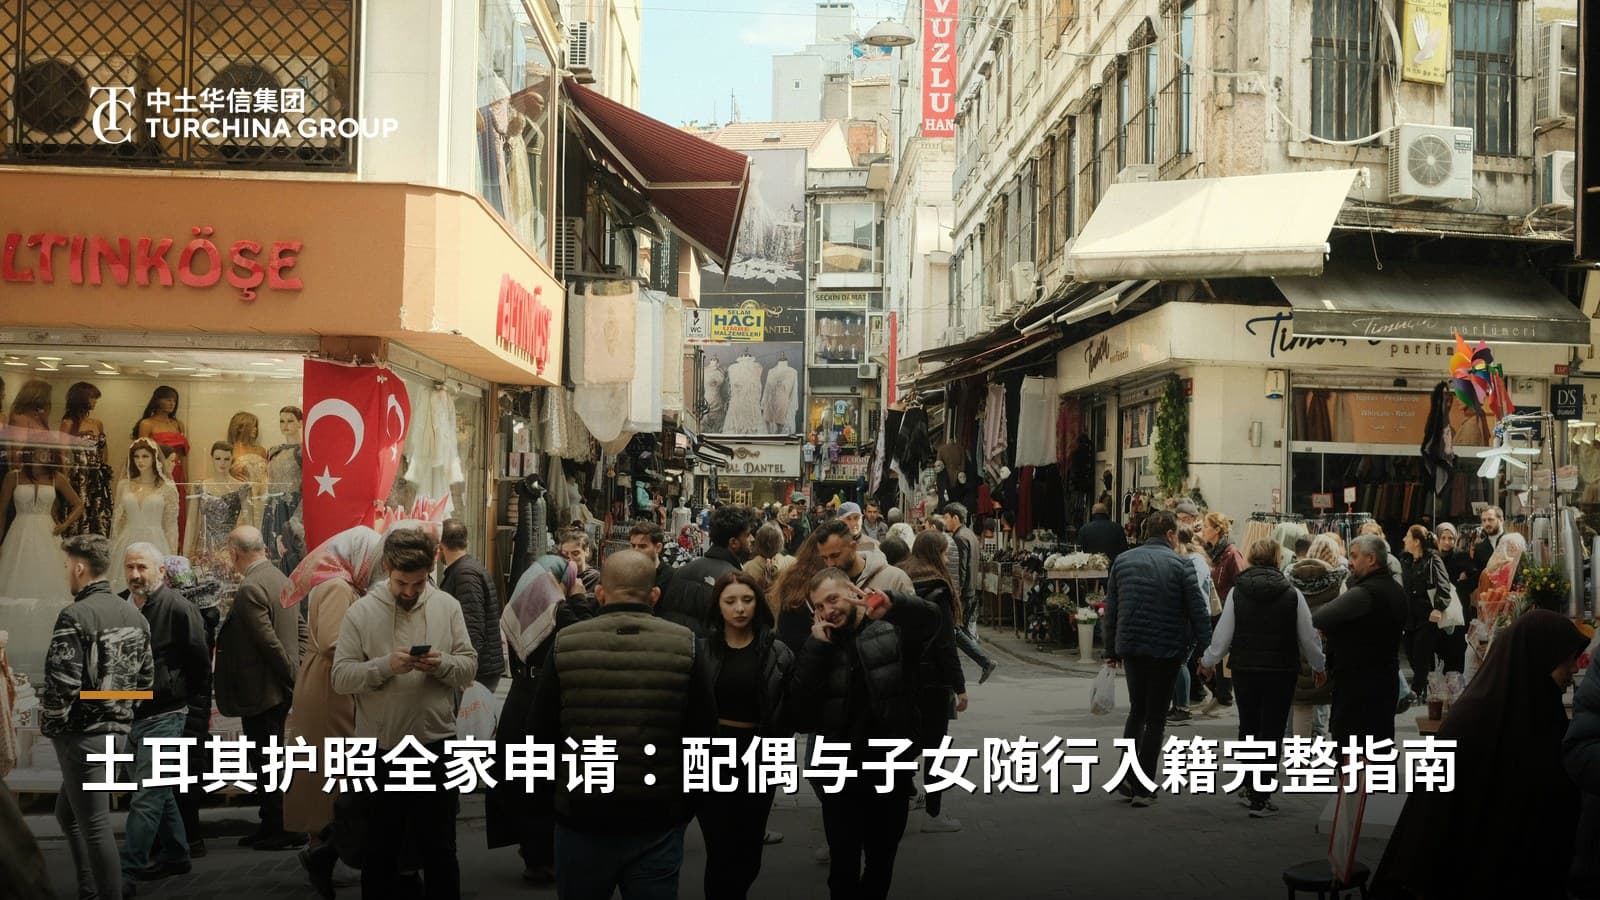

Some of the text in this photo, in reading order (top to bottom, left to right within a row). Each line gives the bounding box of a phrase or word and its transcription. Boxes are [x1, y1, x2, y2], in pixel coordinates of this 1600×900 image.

[1, 226, 304, 301] LTINKÖŞE
[714, 315, 761, 327] HACI
[1390, 342, 1456, 357] parfüm
[743, 461, 786, 474] DANTEL
